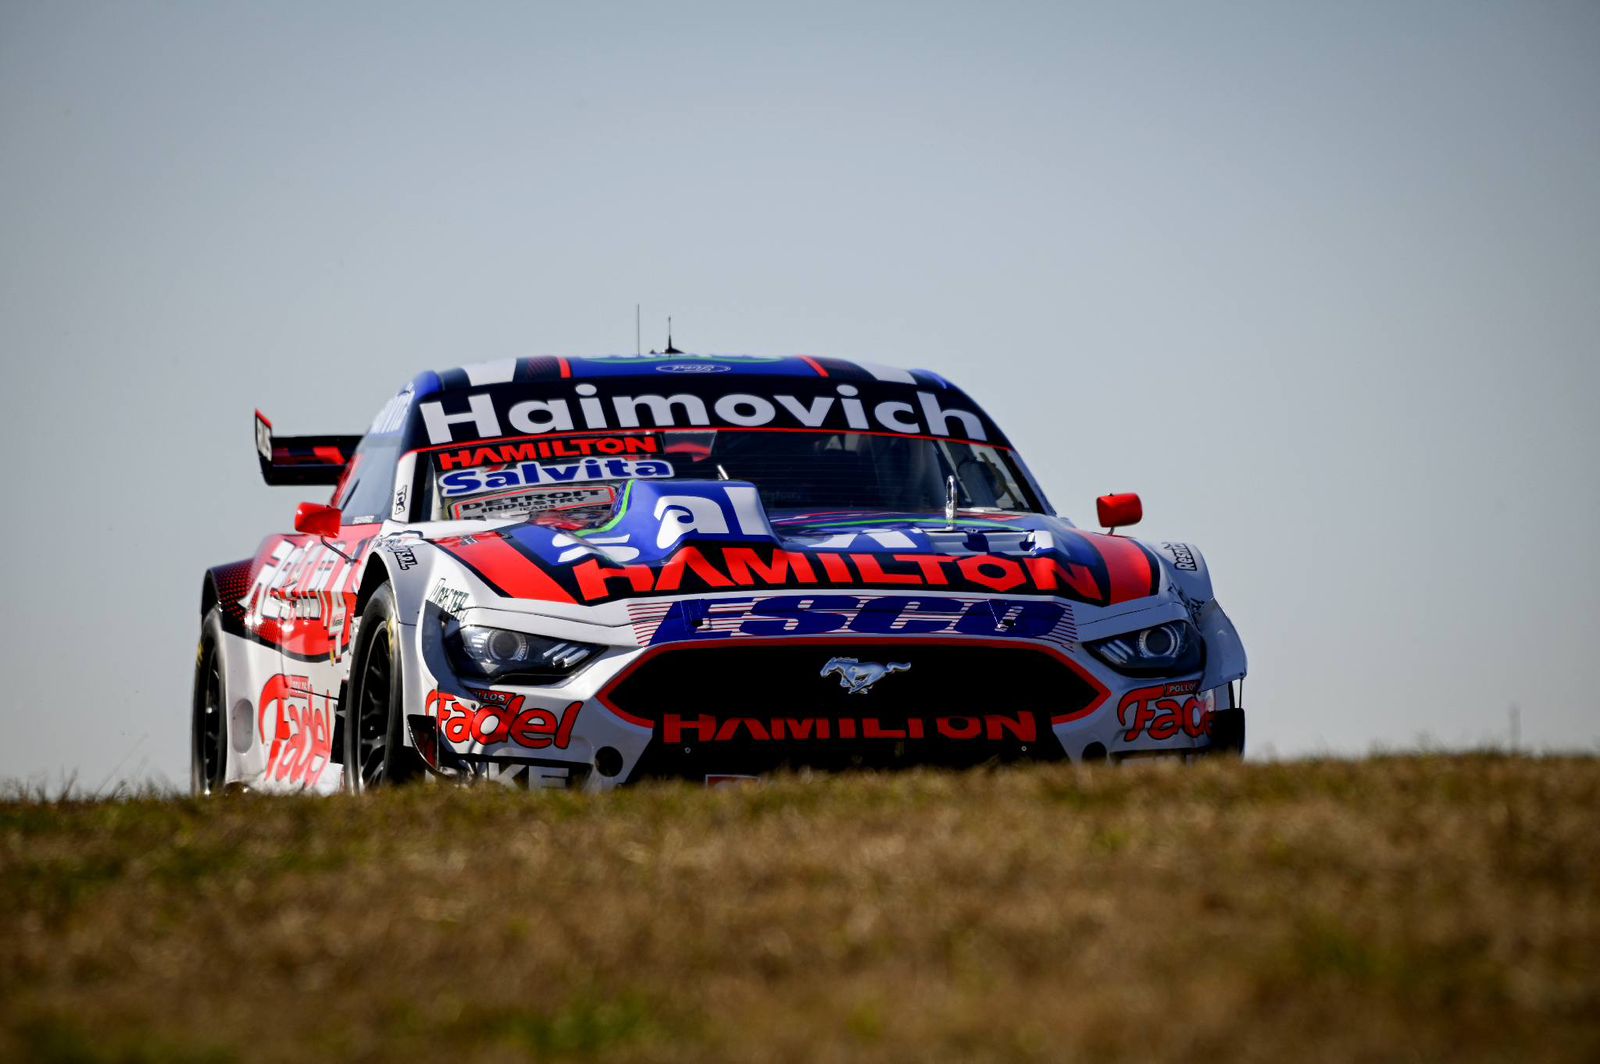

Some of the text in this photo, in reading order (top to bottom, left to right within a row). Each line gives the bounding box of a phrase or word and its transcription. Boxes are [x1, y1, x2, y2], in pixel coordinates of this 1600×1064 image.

[419, 383, 988, 445] Haimovich
[439, 437, 658, 471] HAMILTON
[440, 459, 673, 496] Salvita
[462, 489, 606, 512] DETROIT
[481, 496, 587, 514] INDUSTRY
[573, 546, 1104, 601] HAMILTON
[649, 594, 1068, 643] ESCO
[425, 689, 584, 750] Fadel
[1117, 686, 1216, 742] Fad
